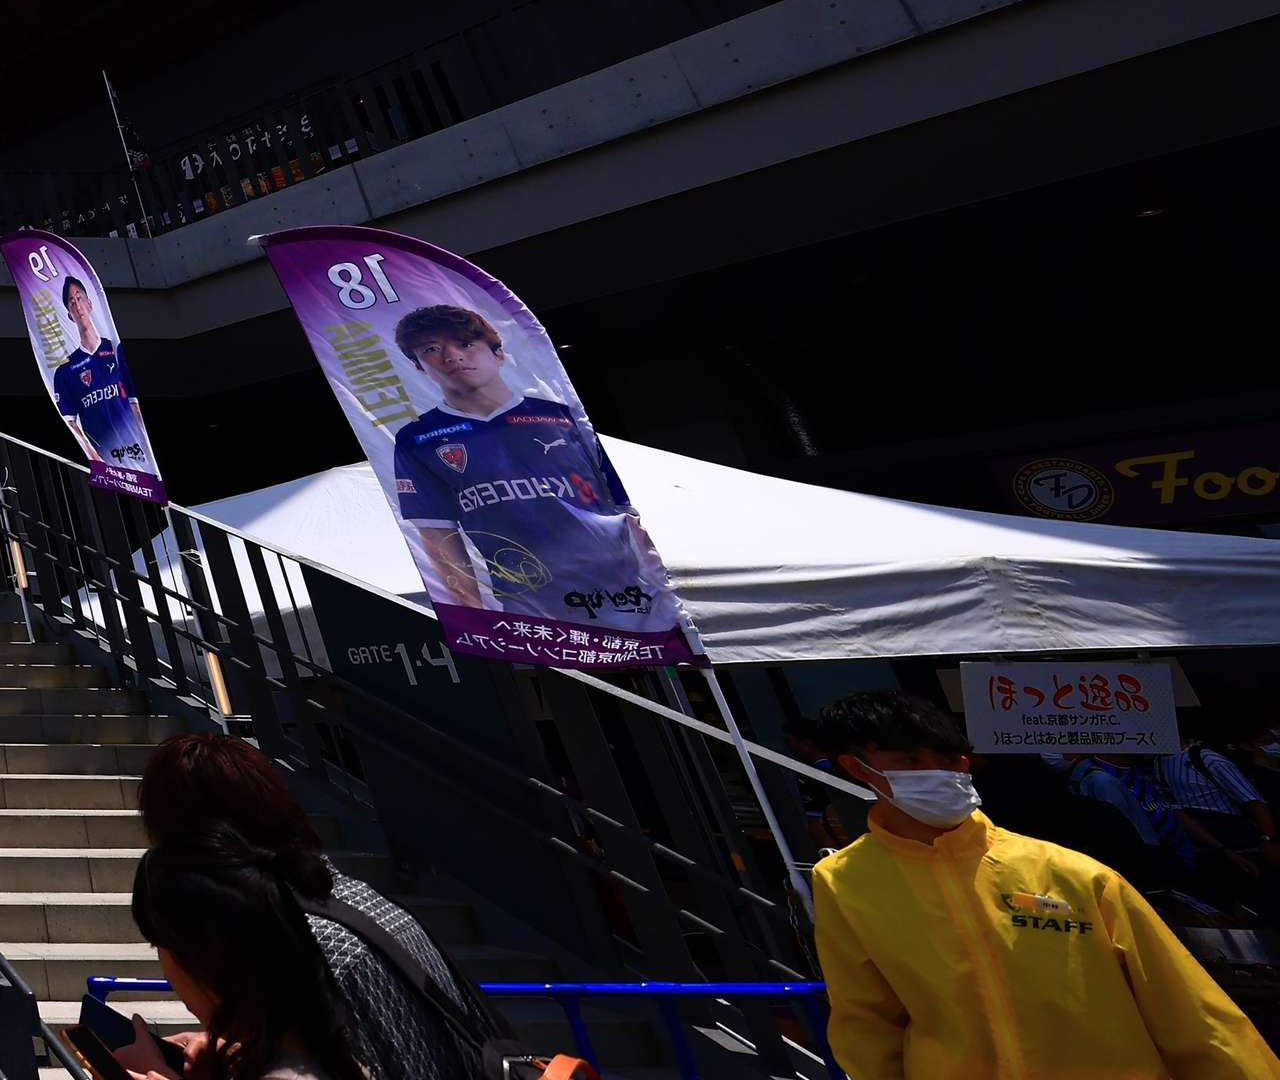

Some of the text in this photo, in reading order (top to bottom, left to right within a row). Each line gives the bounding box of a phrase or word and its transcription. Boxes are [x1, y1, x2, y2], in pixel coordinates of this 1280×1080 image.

[347, 644, 393, 665] GATE
[989, 674, 1151, 713] ほっと逸品
[1021, 713, 1121, 726] feat.京都サンガF.C.
[1011, 914, 1093, 935] STAFF
